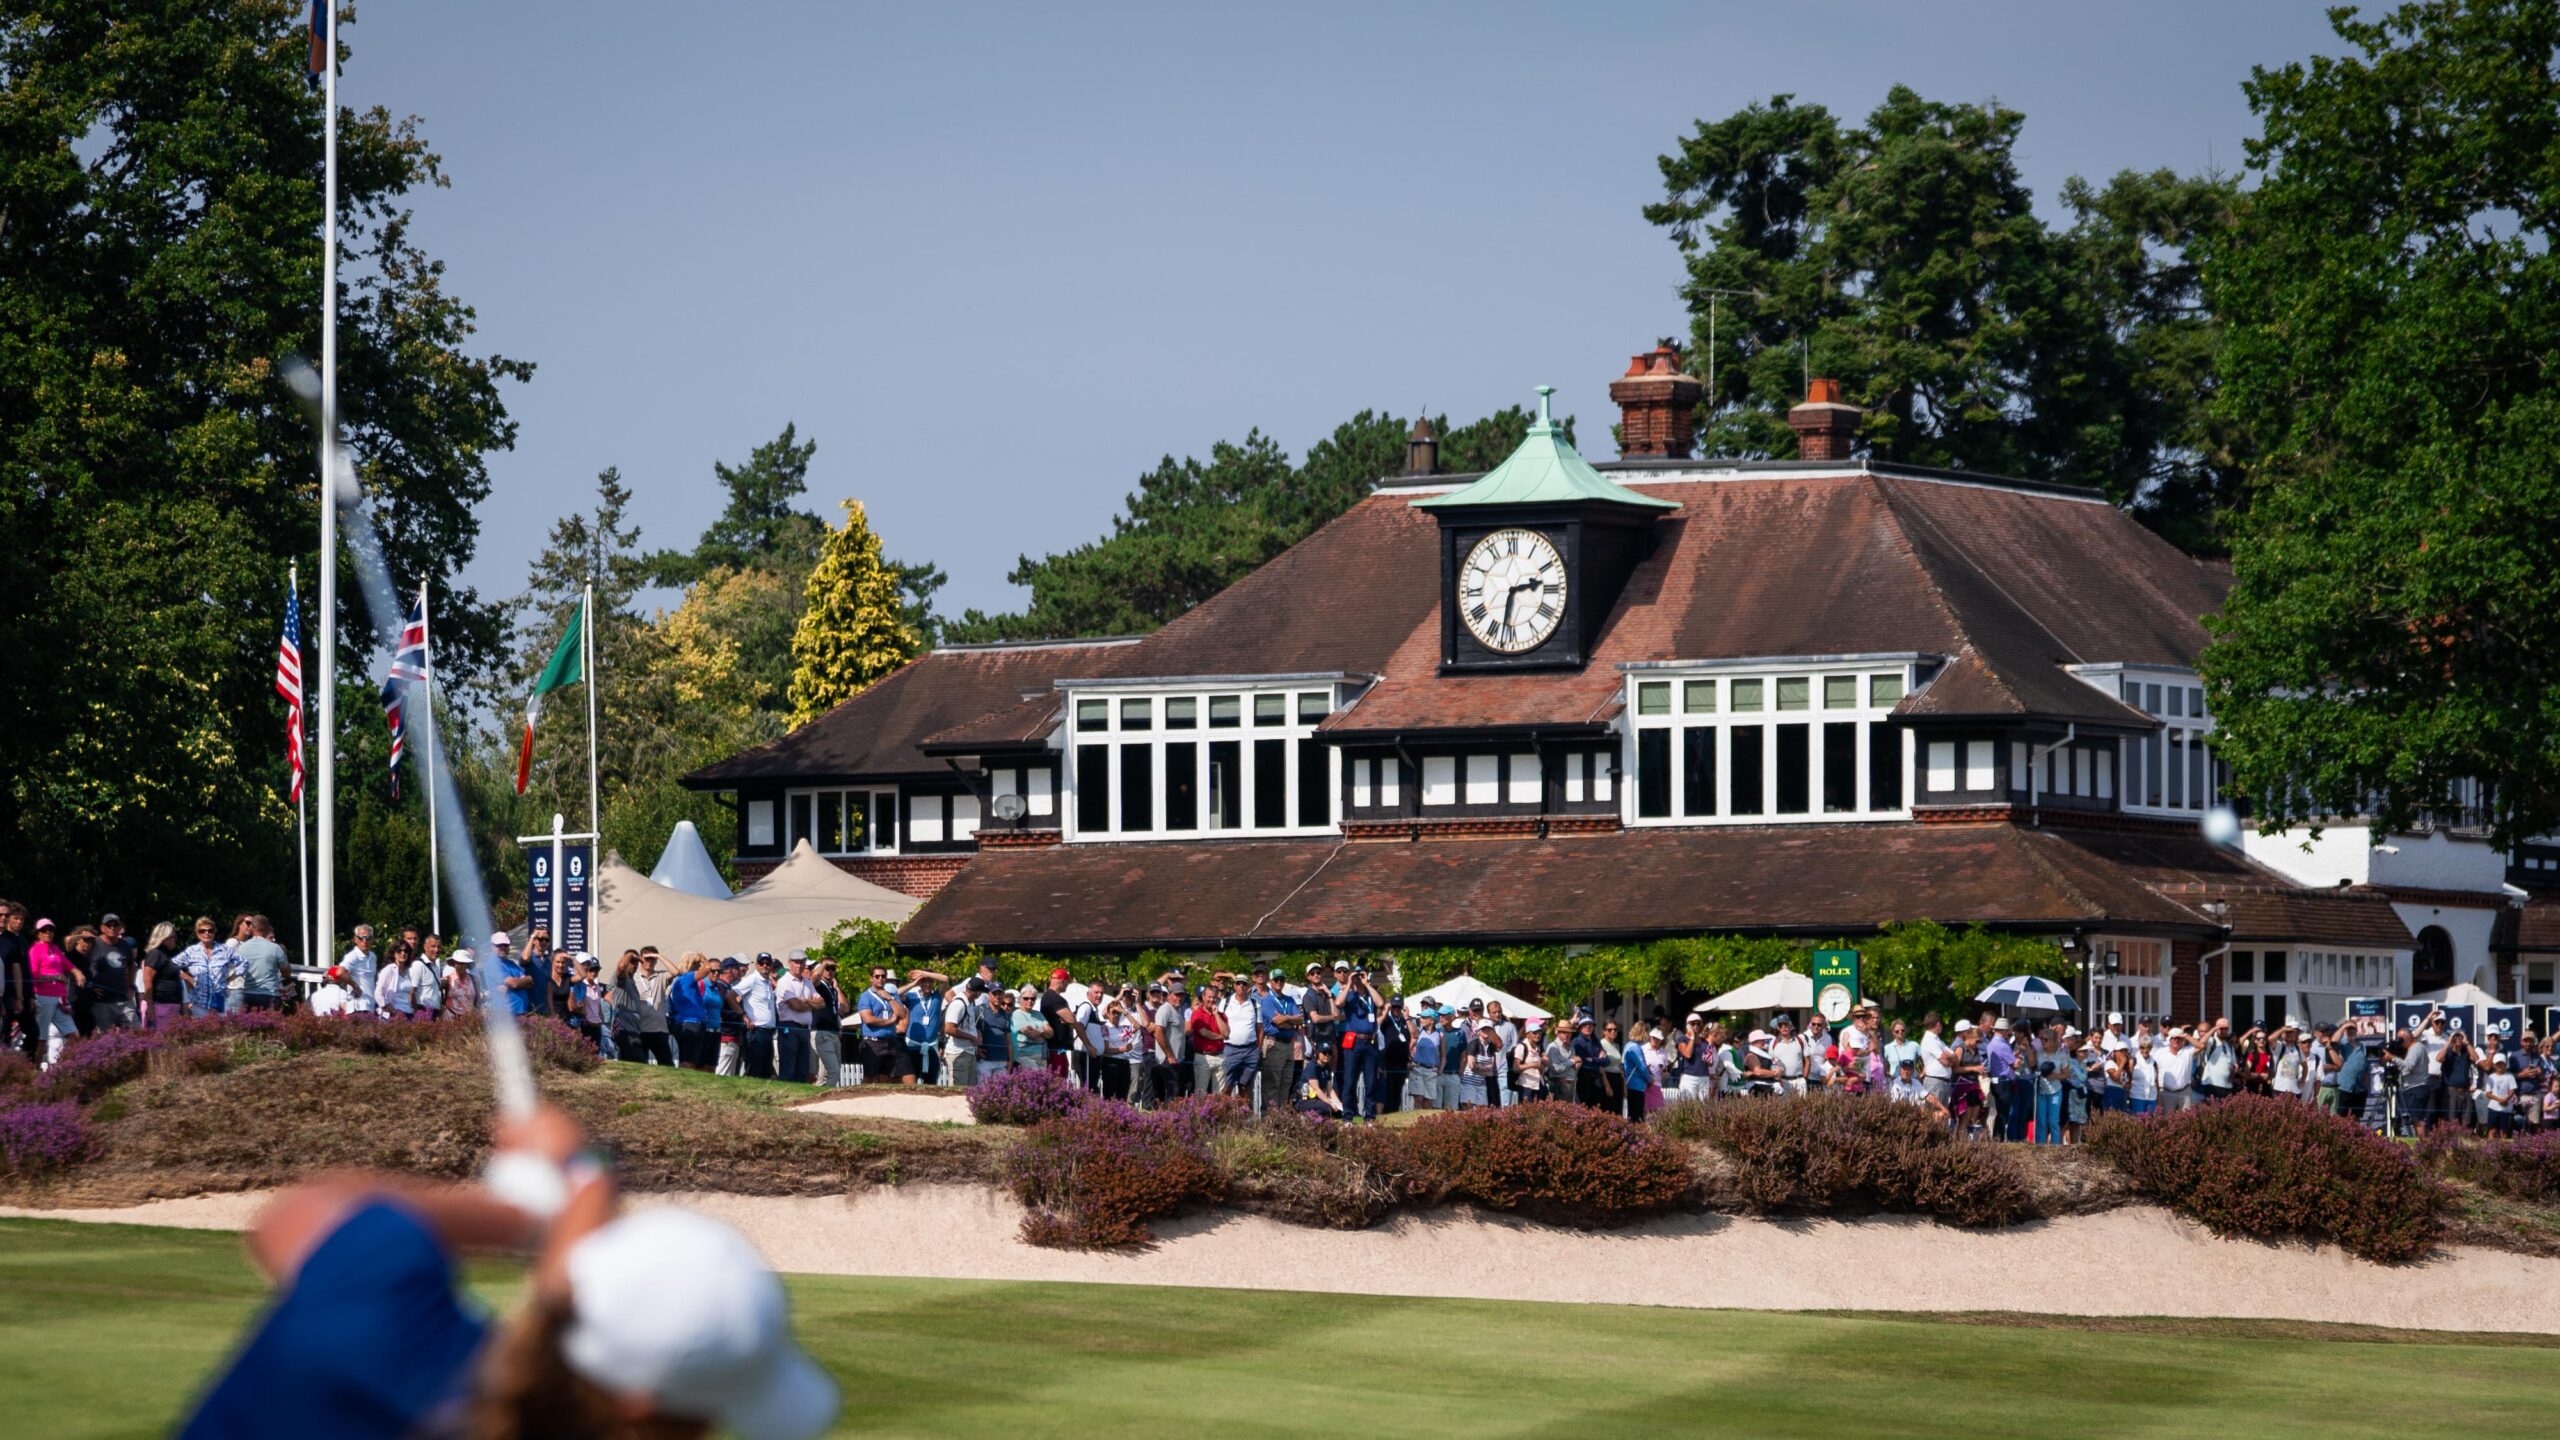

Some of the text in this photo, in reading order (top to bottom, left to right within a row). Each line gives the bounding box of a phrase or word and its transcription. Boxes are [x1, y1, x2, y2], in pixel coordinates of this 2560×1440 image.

[1487, 544, 1501, 560] XI
[1506, 537, 1518, 556] XII
[1527, 544, 1537, 559] I
[1538, 560, 1553, 574] II
[1543, 584, 1559, 594] III
[1528, 620, 1539, 637] V
[1819, 968, 1851, 976] ROLEX
